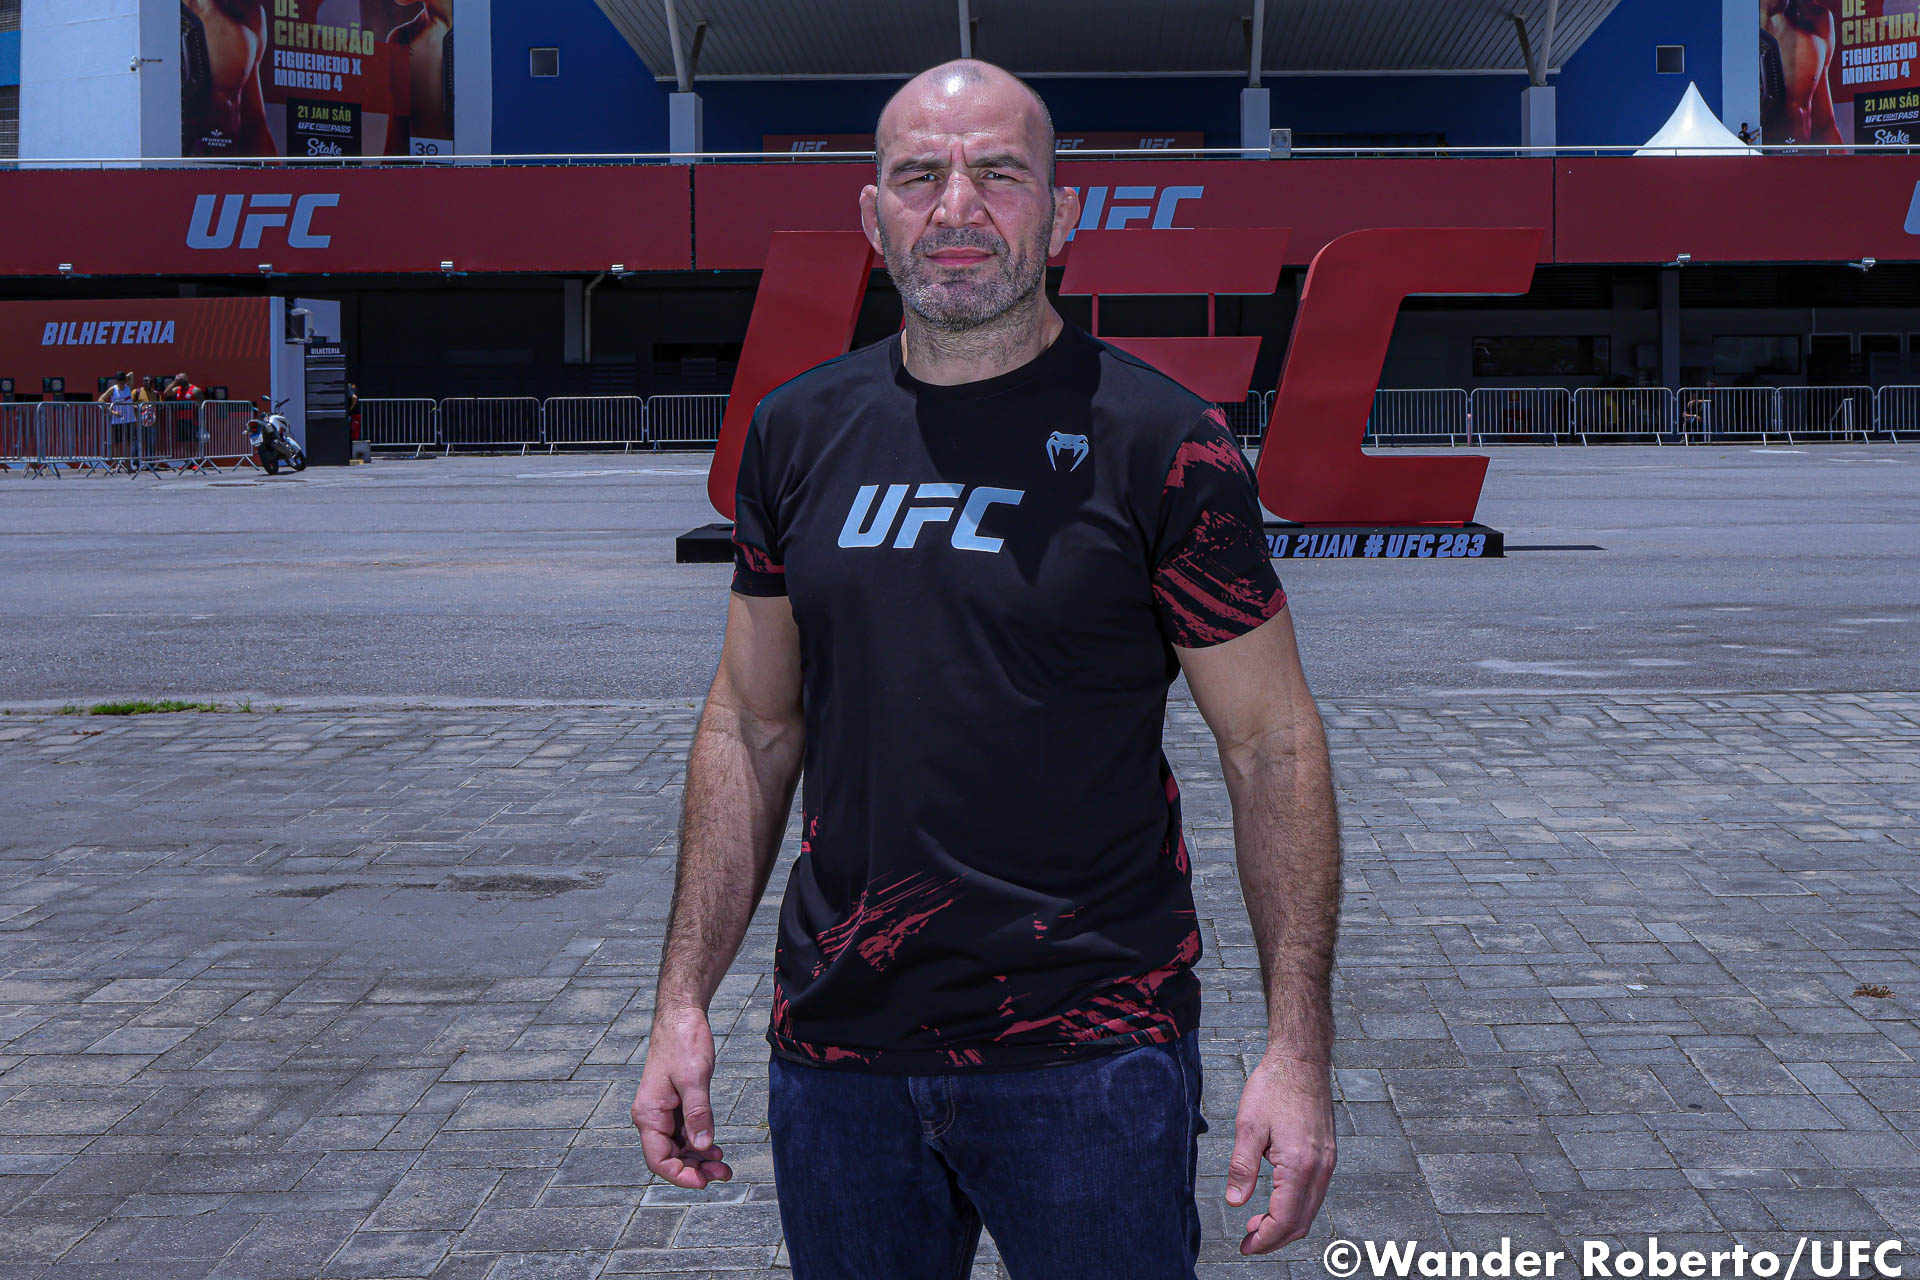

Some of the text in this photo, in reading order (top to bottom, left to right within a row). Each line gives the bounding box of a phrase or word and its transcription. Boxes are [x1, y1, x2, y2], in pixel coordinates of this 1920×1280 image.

[274, 0, 299, 18] DE
[1842, 0, 1866, 18] DE
[274, 20, 374, 55] CINTURÃO
[274, 50, 361, 75] FIGUEIREDO X
[1842, 41, 1917, 67] FIGUEIREDO
[274, 68, 342, 91] MORENO 4
[1842, 61, 1910, 85] MORENO 4
[1864, 91, 1919, 112] 21 JAN SÁB
[297, 105, 352, 122] 21 JAN SÁB
[307, 138, 342, 156] Stake
[1874, 129, 1910, 145] Stake
[186, 193, 340, 249] UFC
[41, 320, 175, 345] BILHETERIA
[837, 483, 1025, 553] UFC
